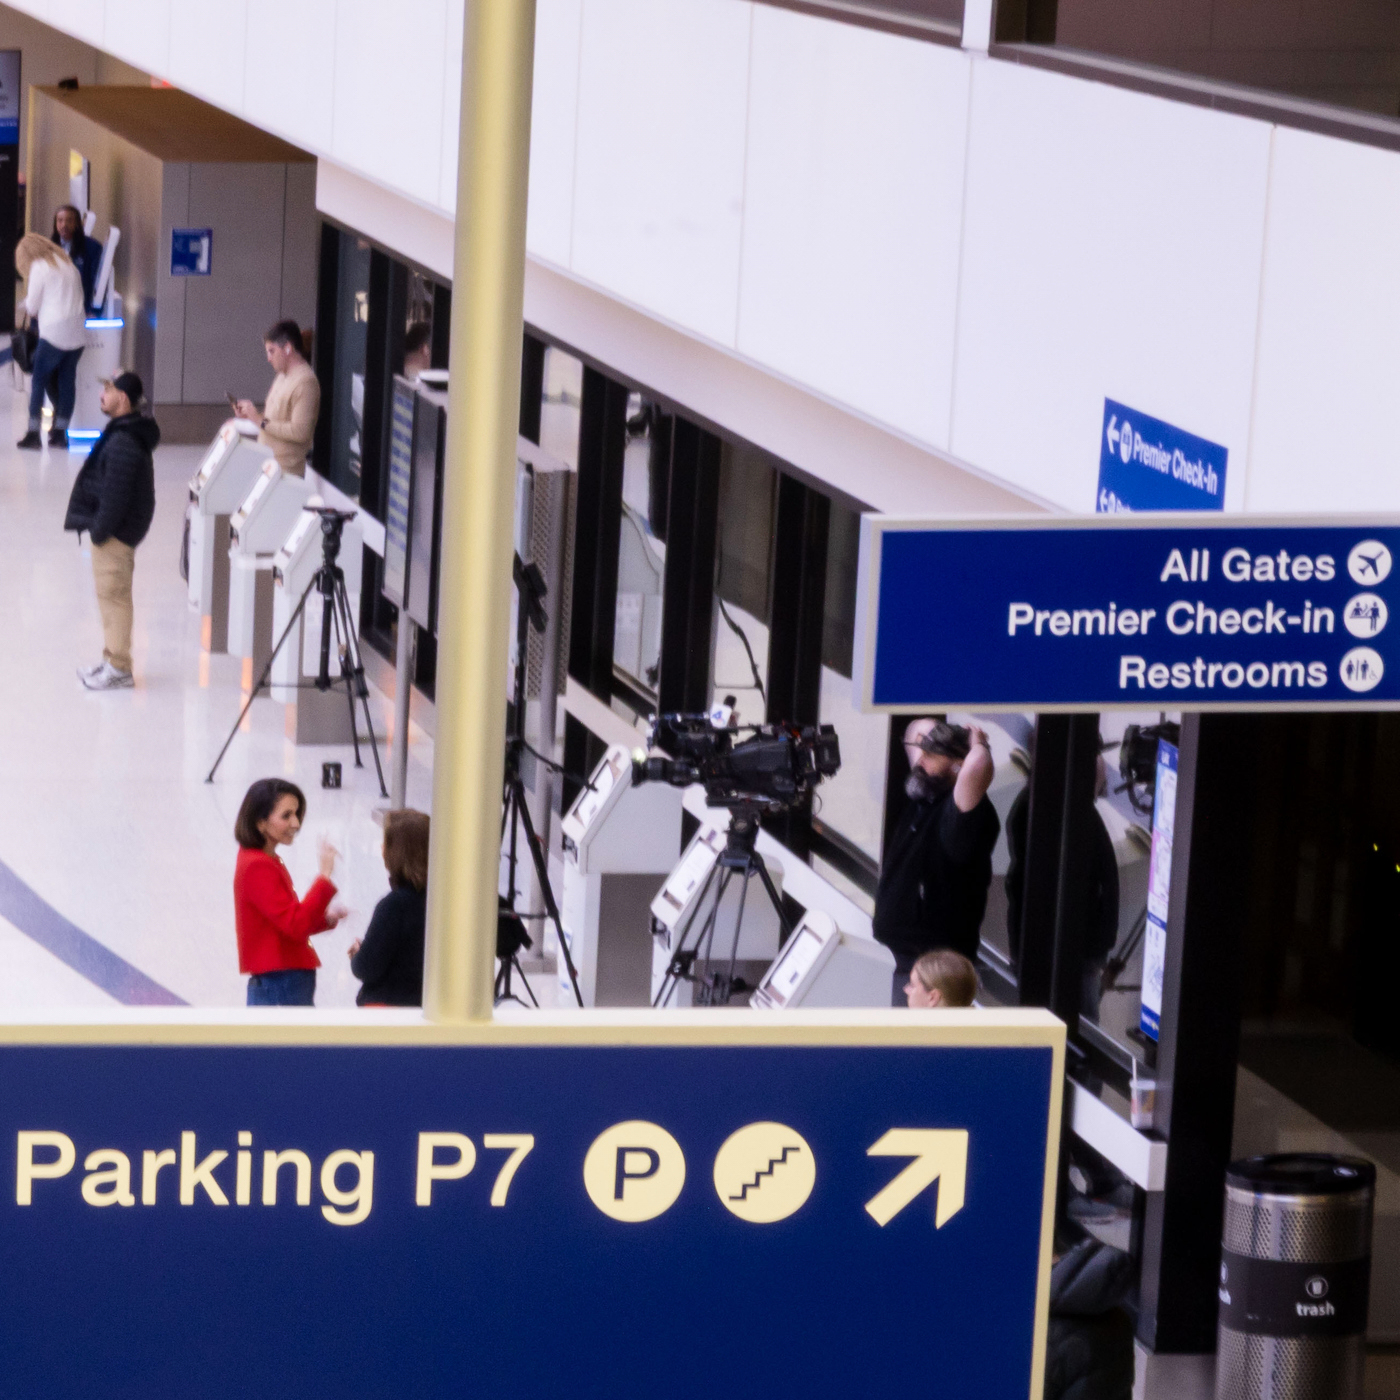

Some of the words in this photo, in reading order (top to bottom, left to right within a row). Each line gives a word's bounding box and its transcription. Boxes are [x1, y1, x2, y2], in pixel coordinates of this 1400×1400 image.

[1133, 430, 1172, 475] Premier
[1172, 447, 1218, 496] Check-In
[1160, 548, 1210, 582] All
[1222, 548, 1336, 582] Gates
[1007, 602, 1156, 637] Premier
[1166, 600, 1335, 636] Check-in
[1119, 655, 1328, 689] Restrooms
[16, 1130, 375, 1226] Parking
[415, 1131, 536, 1207] P7
[1296, 1302, 1335, 1316] trash
